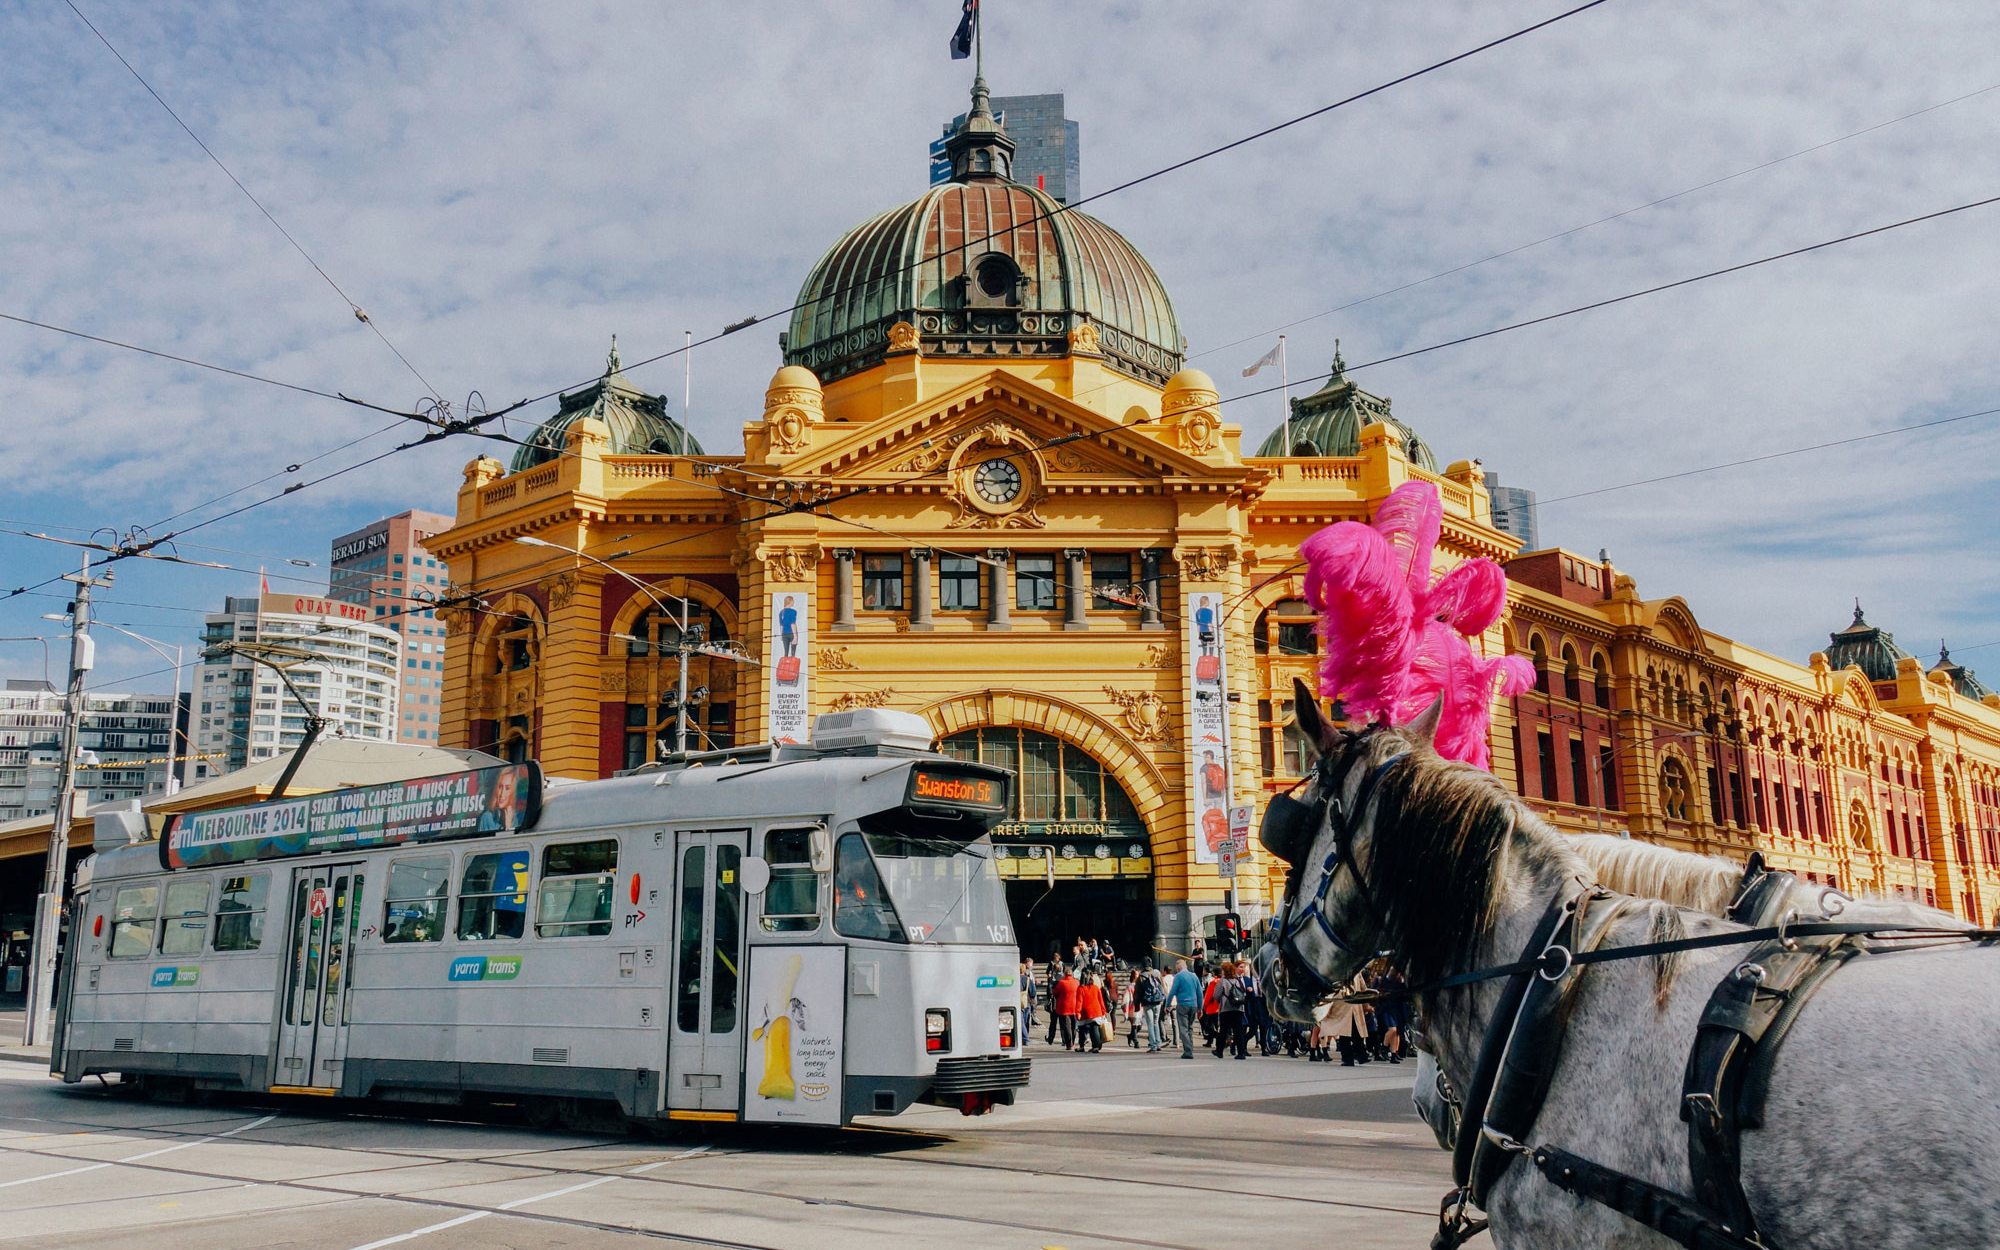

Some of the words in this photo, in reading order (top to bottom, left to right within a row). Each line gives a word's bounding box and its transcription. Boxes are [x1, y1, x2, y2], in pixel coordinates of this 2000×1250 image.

[368, 532, 387, 549] SUN
[295, 598, 332, 614] QUAY
[340, 604, 366, 621] WEST
[312, 796, 338, 815] START
[341, 792, 365, 810] YOUR
[368, 787, 403, 806] CAREER
[406, 786, 418, 801] IN
[420, 780, 452, 800] MUSIC
[455, 778, 470, 795] AT
[917, 774, 975, 800] Swanston
[977, 782, 991, 802] St
[310, 816, 326, 832] THE
[328, 808, 384, 829] AUSTRALIAN
[387, 801, 432, 822] INSTITUTE
[436, 800, 450, 816] OF
[452, 794, 486, 814] MUSIC
[193, 811, 268, 842] MELBOURNE
[272, 805, 306, 832] 2014
[1046, 824, 1105, 835] STATION
[309, 836, 338, 846] INFORMATION
[339, 832, 357, 842] EVENING
[358, 830, 384, 840] WEDNESDAY
[418, 824, 430, 833] VISIT
[312, 892, 325, 902] STOP
[987, 925, 1008, 942] 167
[154, 972, 173, 984] yarra
[177, 971, 197, 981] trams
[454, 963, 480, 978] yarra
[488, 961, 516, 974] trams
[801, 1036, 831, 1046] Nature's
[797, 1049, 810, 1060] long
[812, 1048, 836, 1060] lasting
[804, 1061, 828, 1070] energy
